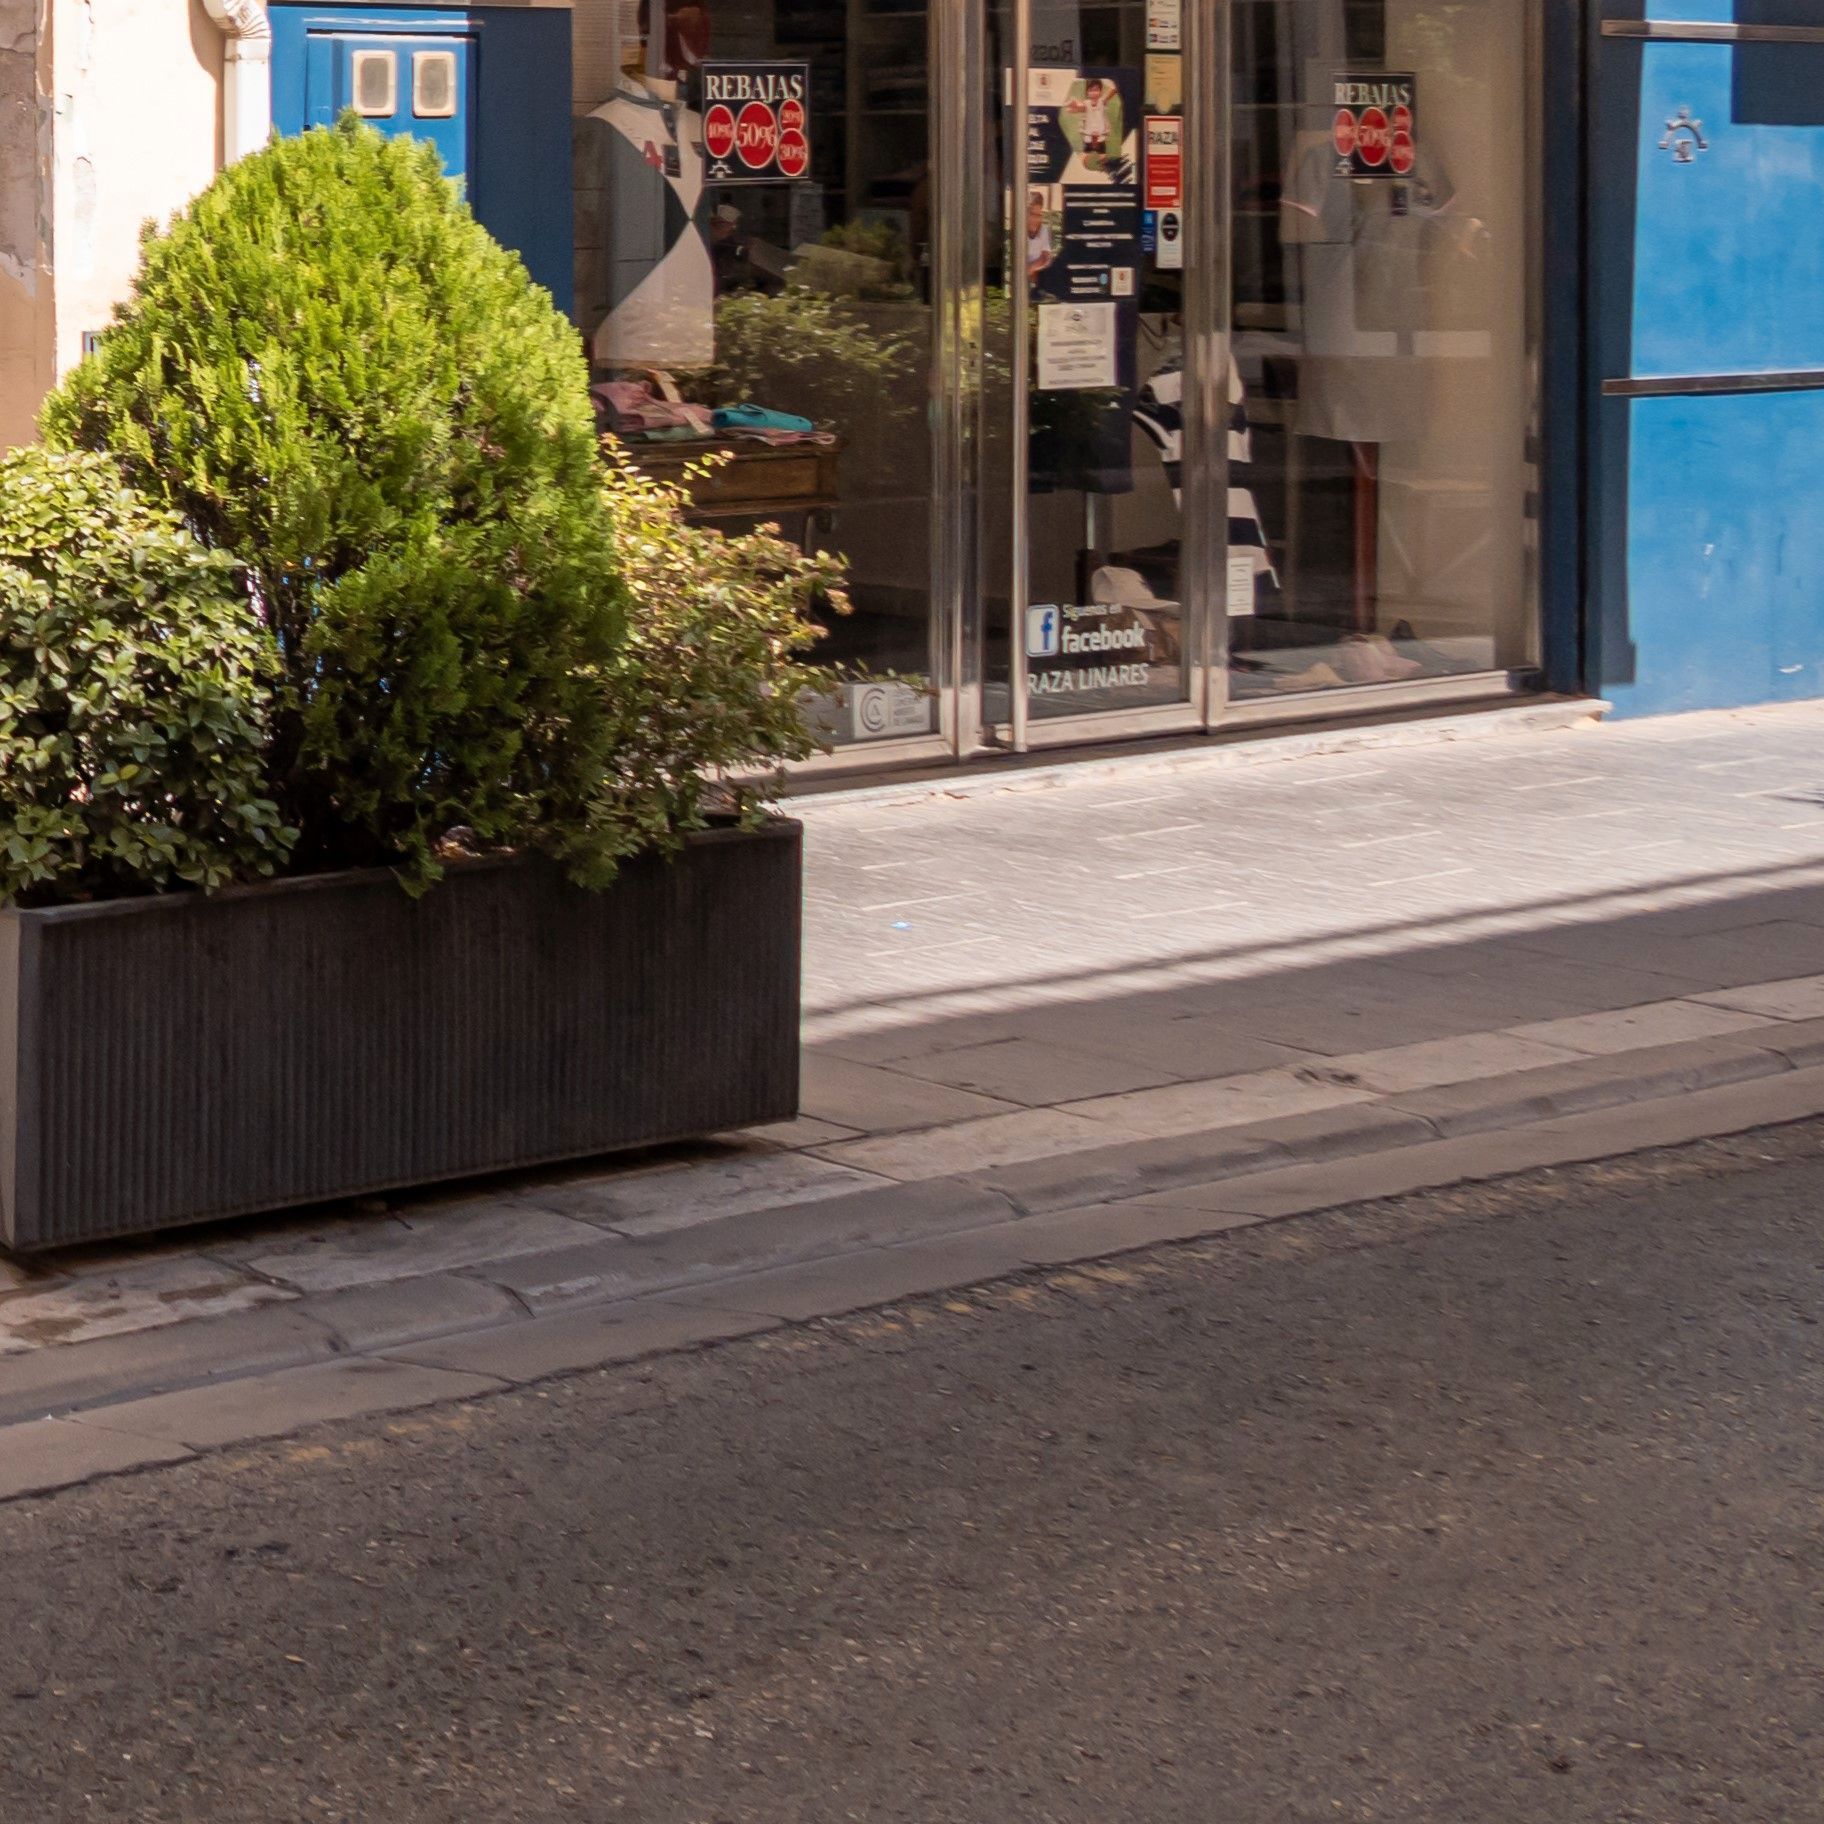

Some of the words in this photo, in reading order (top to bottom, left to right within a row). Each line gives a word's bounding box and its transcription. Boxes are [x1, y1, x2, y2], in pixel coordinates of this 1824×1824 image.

[706, 74, 803, 104] REBAJAS
[1334, 83, 1410, 109] REBAJAS
[735, 123, 777, 149] 50%
[1061, 621, 1146, 654] facebook
[1027, 670, 1074, 694] RAZA
[1078, 662, 1150, 690] LINARES
